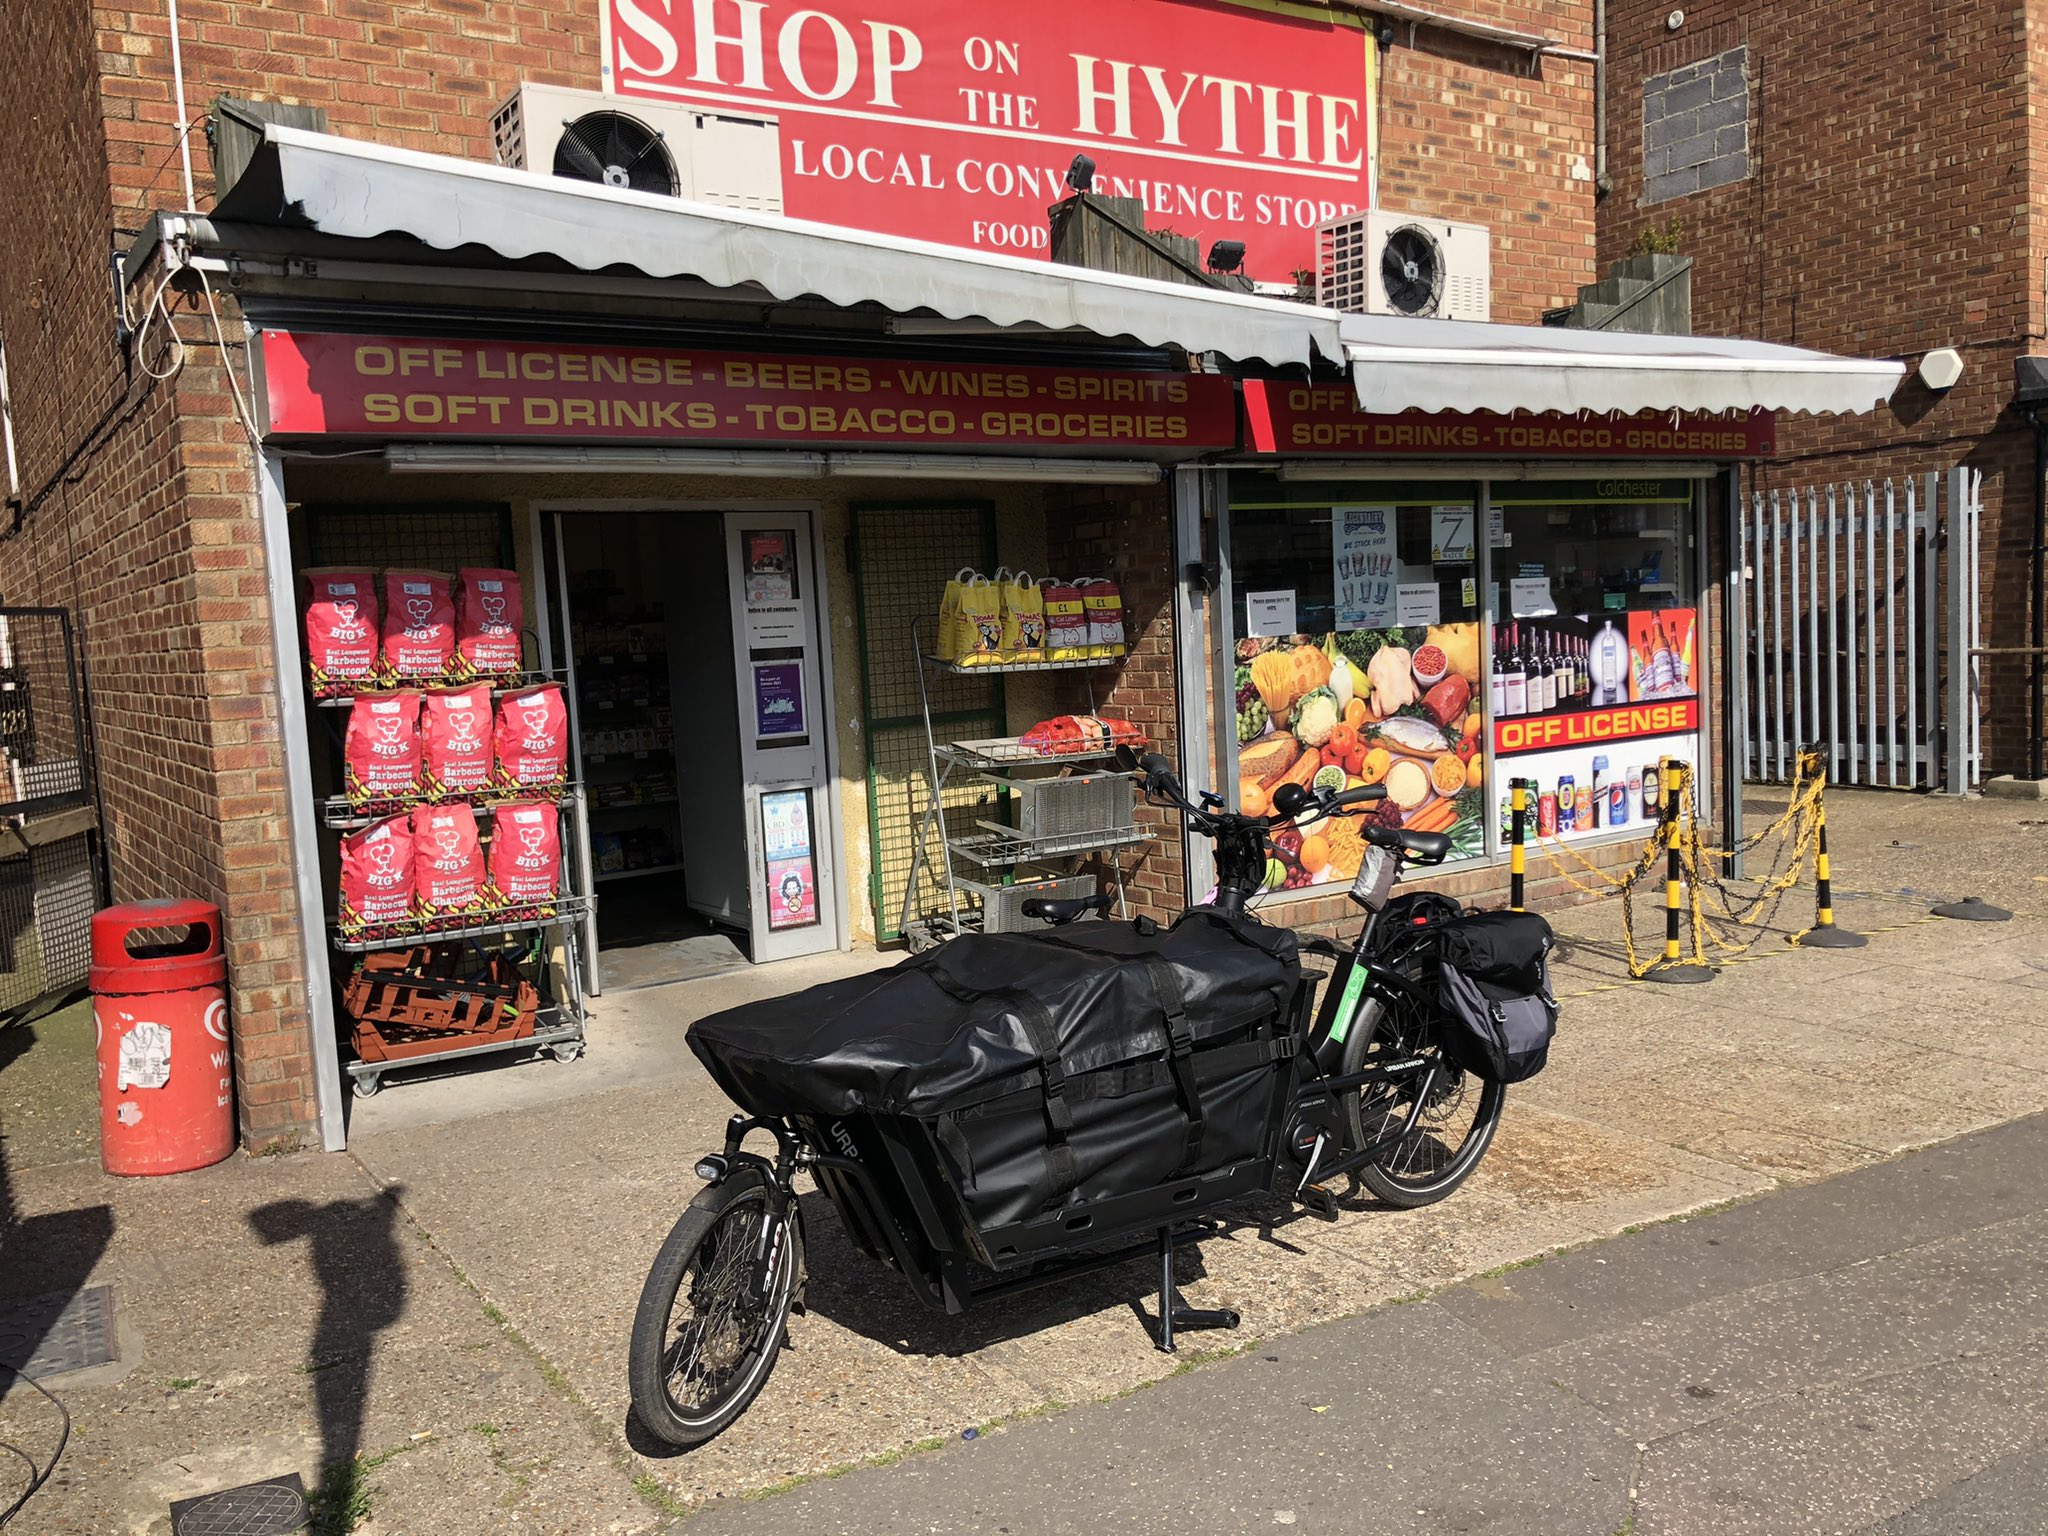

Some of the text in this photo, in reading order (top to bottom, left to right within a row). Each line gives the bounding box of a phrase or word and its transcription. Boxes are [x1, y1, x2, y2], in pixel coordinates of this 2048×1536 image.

[618, 0, 1363, 171] SHOP ON THE HYTHE
[793, 139, 945, 190] LOCAL
[956, 159, 1246, 223] CONVENIENCE
[972, 220, 1048, 249] FOOD
[355, 346, 463, 377] OFF
[477, 350, 693, 385] LICENSE
[723, 361, 872, 393] BEERS
[900, 369, 1029, 399] WINES
[1054, 376, 1189, 403] SPIRITS
[1289, 389, 1346, 412] OFF
[364, 393, 510, 425] SOFT
[523, 397, 717, 429] DRINKS
[746, 404, 956, 435] TOBACCO
[981, 412, 1188, 439] GROCERIES
[1291, 422, 1369, 445] SOFT
[1374, 424, 1479, 447] DRINKS
[1493, 426, 1611, 448] TOBACCO
[1625, 429, 1747, 450] GROCERIES
[1596, 479, 1661, 497] Colchester
[1058, 604, 1068, 612] £1
[1097, 599, 1106, 607] £1
[329, 627, 368, 641] BIG K
[402, 624, 442, 639] BIG K
[479, 622, 514, 635] BIG K
[326, 655, 370, 665] Barbecue
[399, 655, 442, 664] Barbecue
[476, 650, 515, 659] Barbecue
[1501, 705, 1687, 748] OFF LICENSE
[371, 740, 410, 755] BIG K
[446, 738, 483, 752] BIG K
[521, 736, 556, 750] BIG K
[369, 771, 412, 780] Barbecue
[444, 767, 485, 776] Barbecue
[519, 763, 558, 774] Barbecue
[433, 856, 470, 870] BIG K
[516, 854, 550, 868] BIG K
[367, 870, 404, 886] BIG K
[432, 884, 474, 896] Barbecue
[510, 882, 550, 892] Barbecue
[364, 899, 407, 910] Barbecue
[831, 1120, 864, 1163] URB
